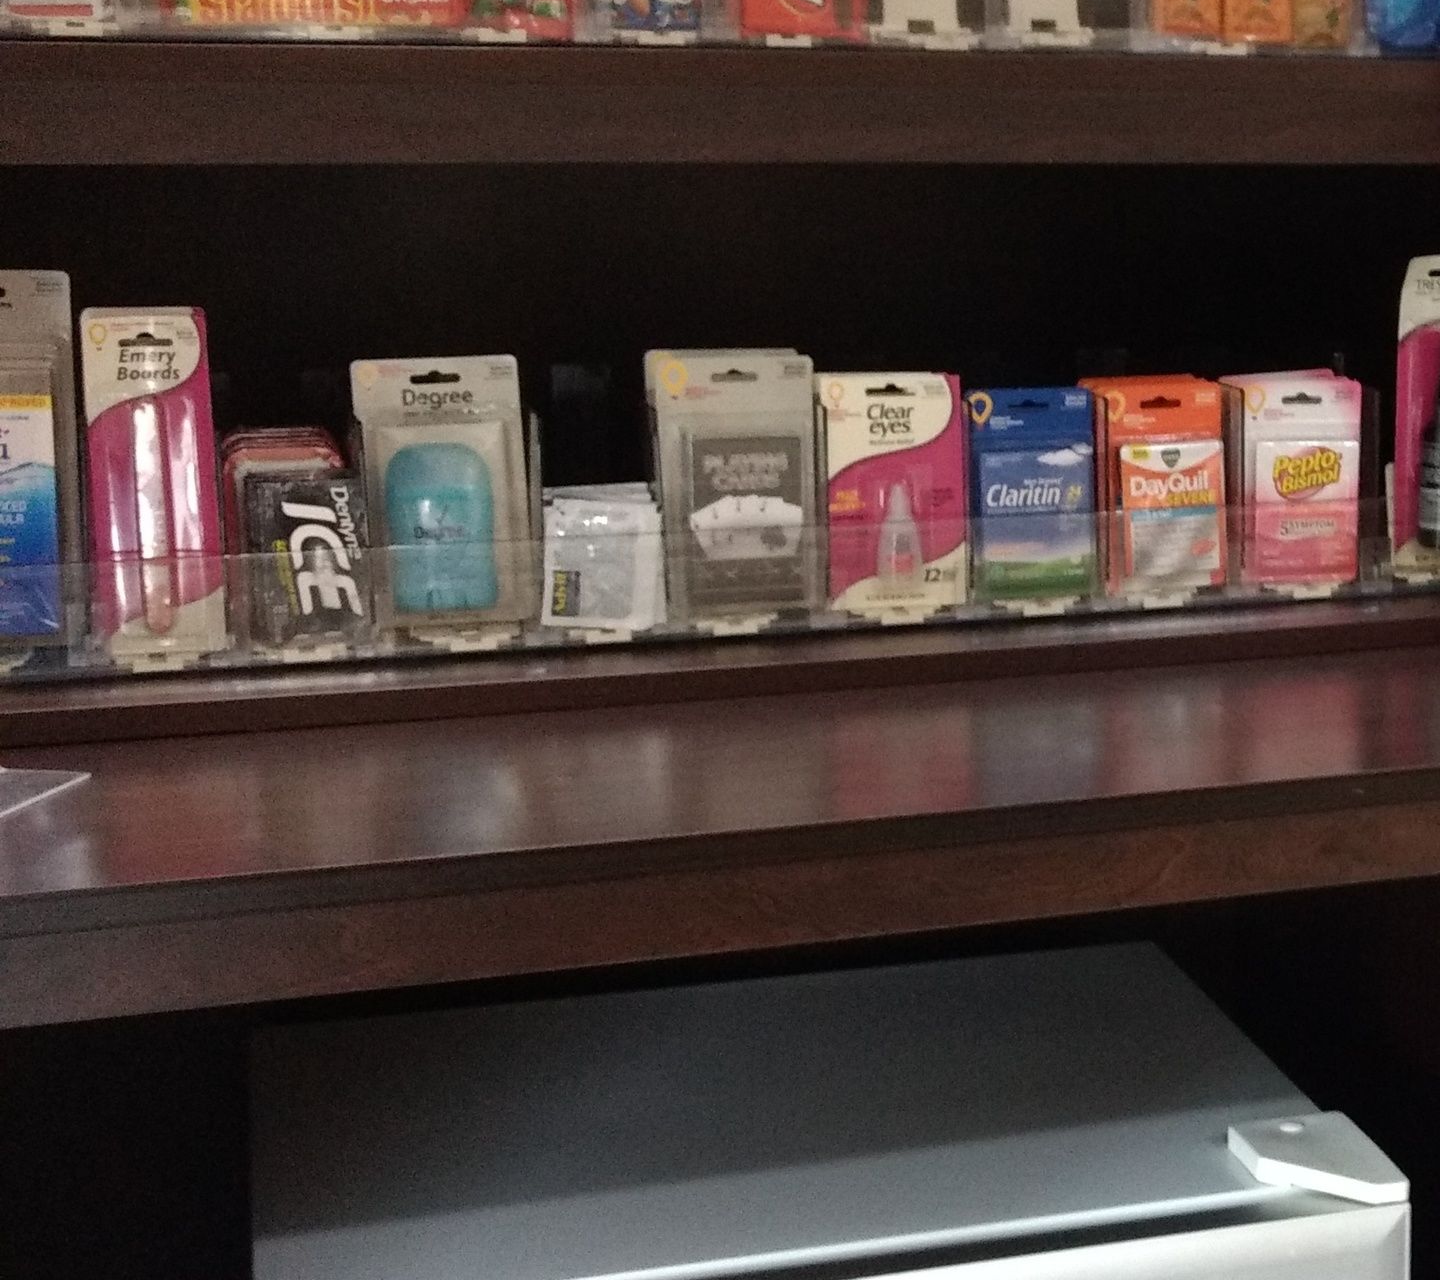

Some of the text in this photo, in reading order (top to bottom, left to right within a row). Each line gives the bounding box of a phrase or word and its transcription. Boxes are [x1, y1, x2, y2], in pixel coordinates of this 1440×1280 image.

[118, 348, 176, 368] Emery
[117, 367, 180, 381] Boards
[402, 389, 474, 411] Degree
[866, 403, 915, 422] Clear
[869, 420, 912, 439] eyes
[1129, 469, 1209, 501] DayQuil
[1282, 464, 1341, 493] Bismol
[986, 483, 1062, 509] Claritin
[330, 485, 363, 560] Dentyne
[280, 500, 365, 618] ICE
[923, 568, 941, 583] 12
